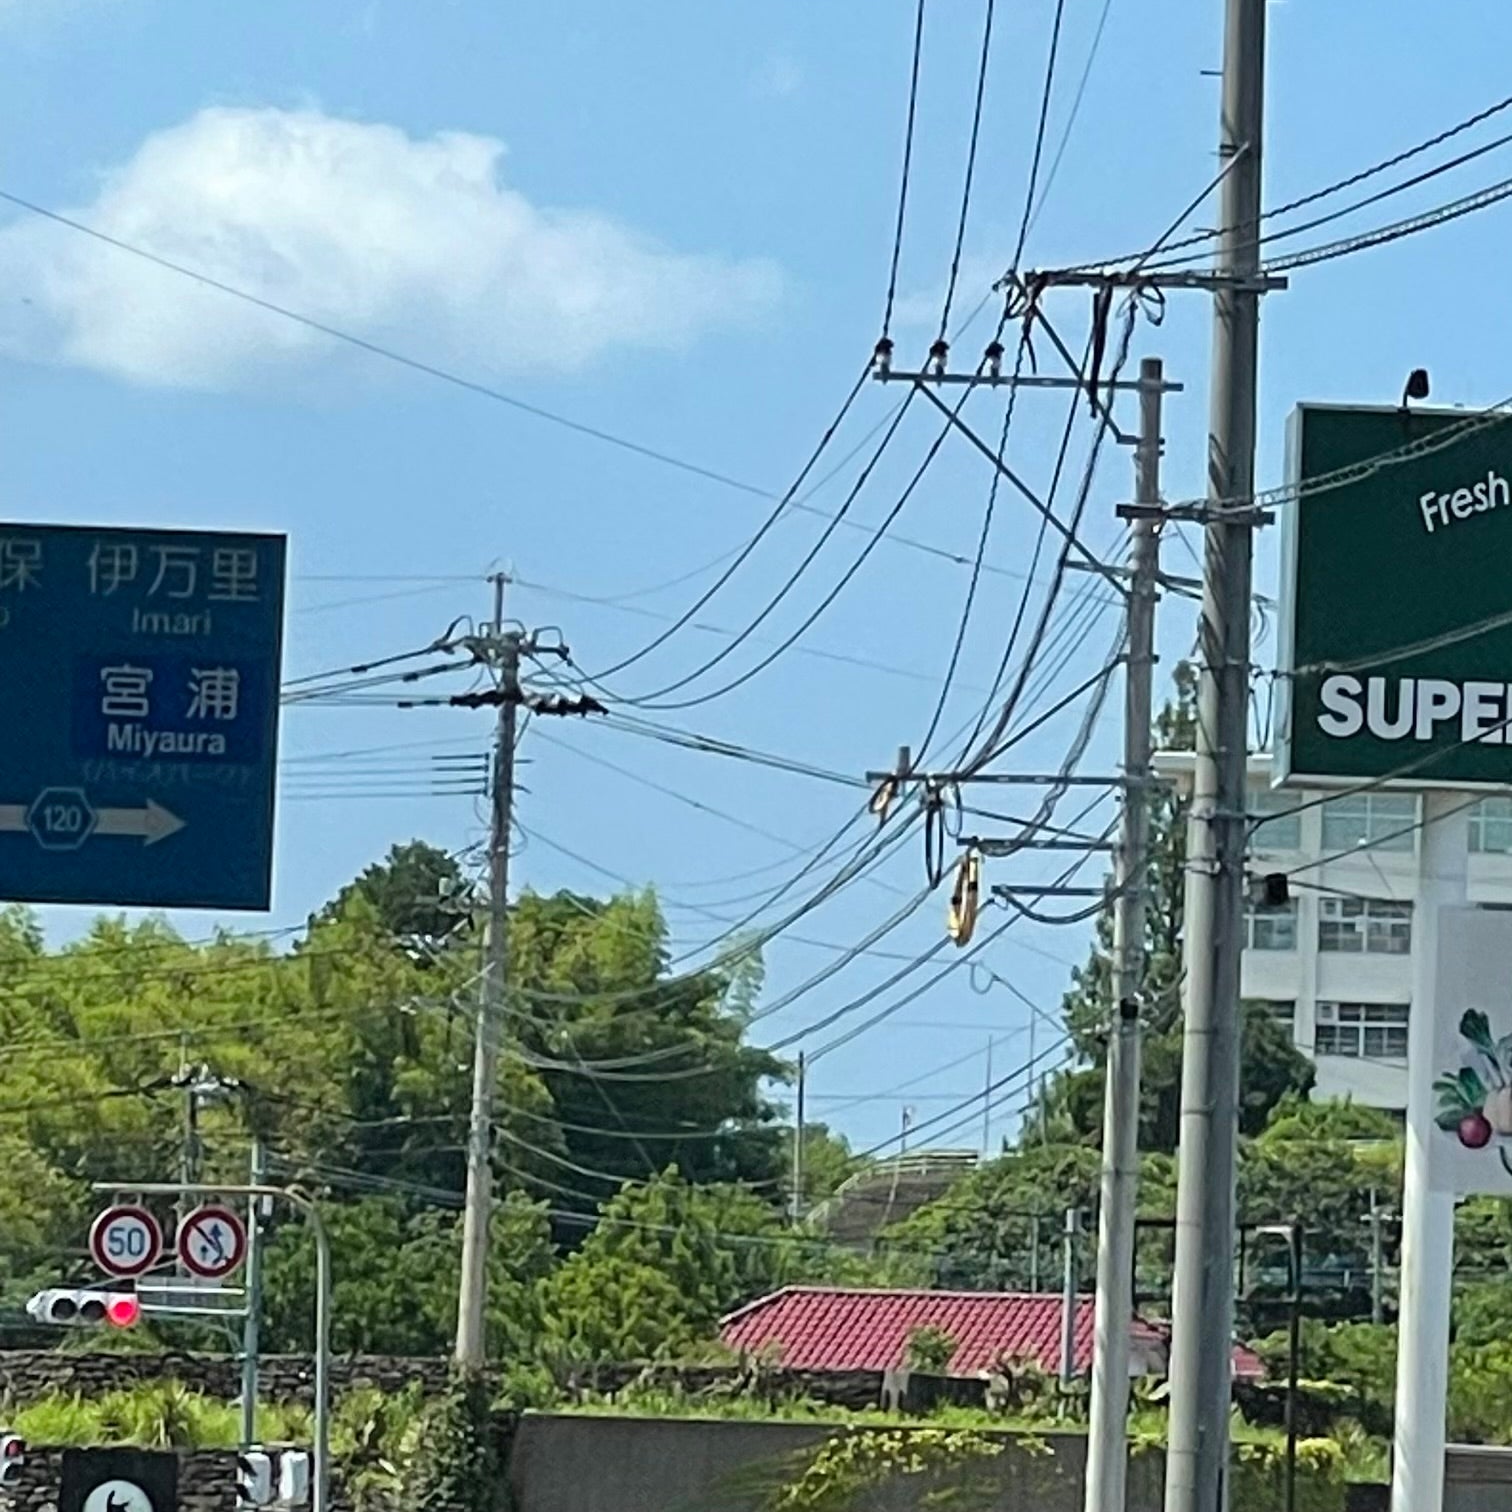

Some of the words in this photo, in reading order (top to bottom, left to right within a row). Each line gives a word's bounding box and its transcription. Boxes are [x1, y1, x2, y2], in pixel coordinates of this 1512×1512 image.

[1420, 472, 1510, 532] Fresh
[88, 544, 259, 600] 伊万里
[132, 607, 211, 635] Imari
[108, 724, 226, 757] Miyaura
[44, 808, 81, 832] 120
[108, 1227, 145, 1257] 50
